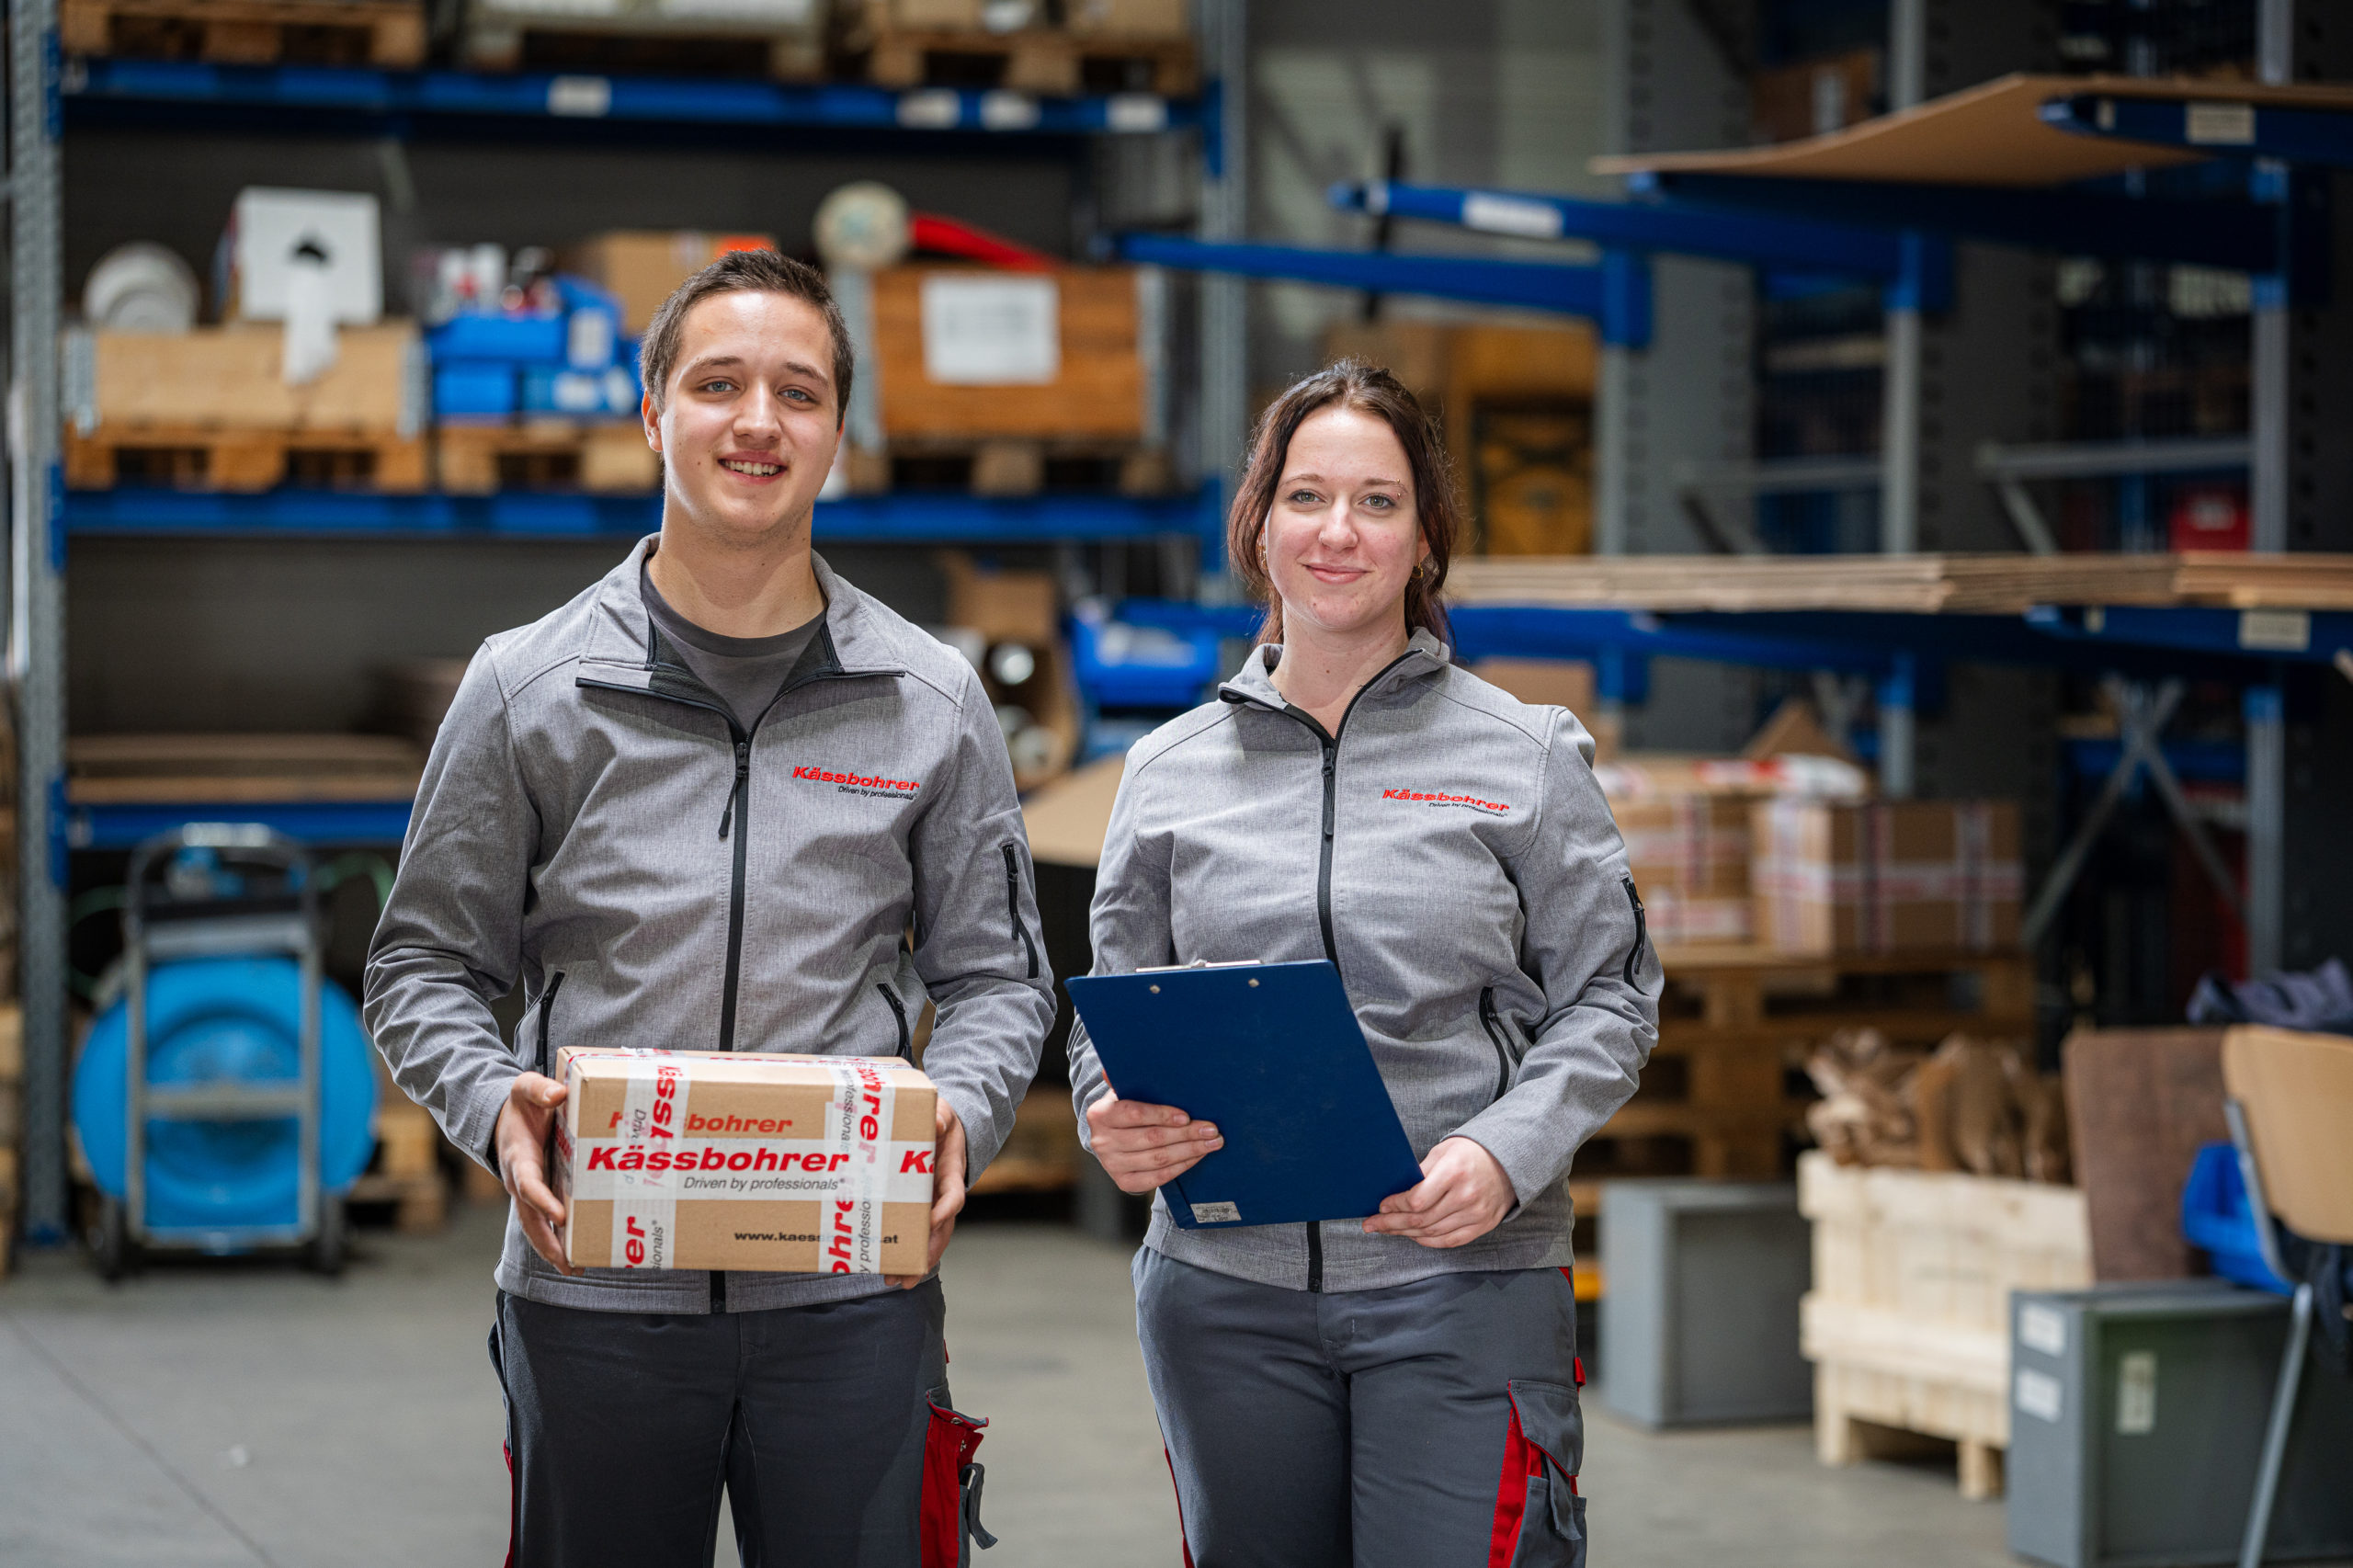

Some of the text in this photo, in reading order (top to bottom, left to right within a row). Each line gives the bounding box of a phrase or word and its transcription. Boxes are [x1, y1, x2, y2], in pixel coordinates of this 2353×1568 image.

[792, 766, 919, 791] Kässbohrer
[838, 786, 859, 795] Driven
[860, 788, 870, 798] by
[1382, 789, 1509, 812] Kässbohrer
[587, 1145, 849, 1172] Kässbohrer
[899, 1150, 935, 1174] K
[684, 1176, 726, 1189] Driven
[730, 1176, 748, 1191] by
[625, 1216, 645, 1268] er
